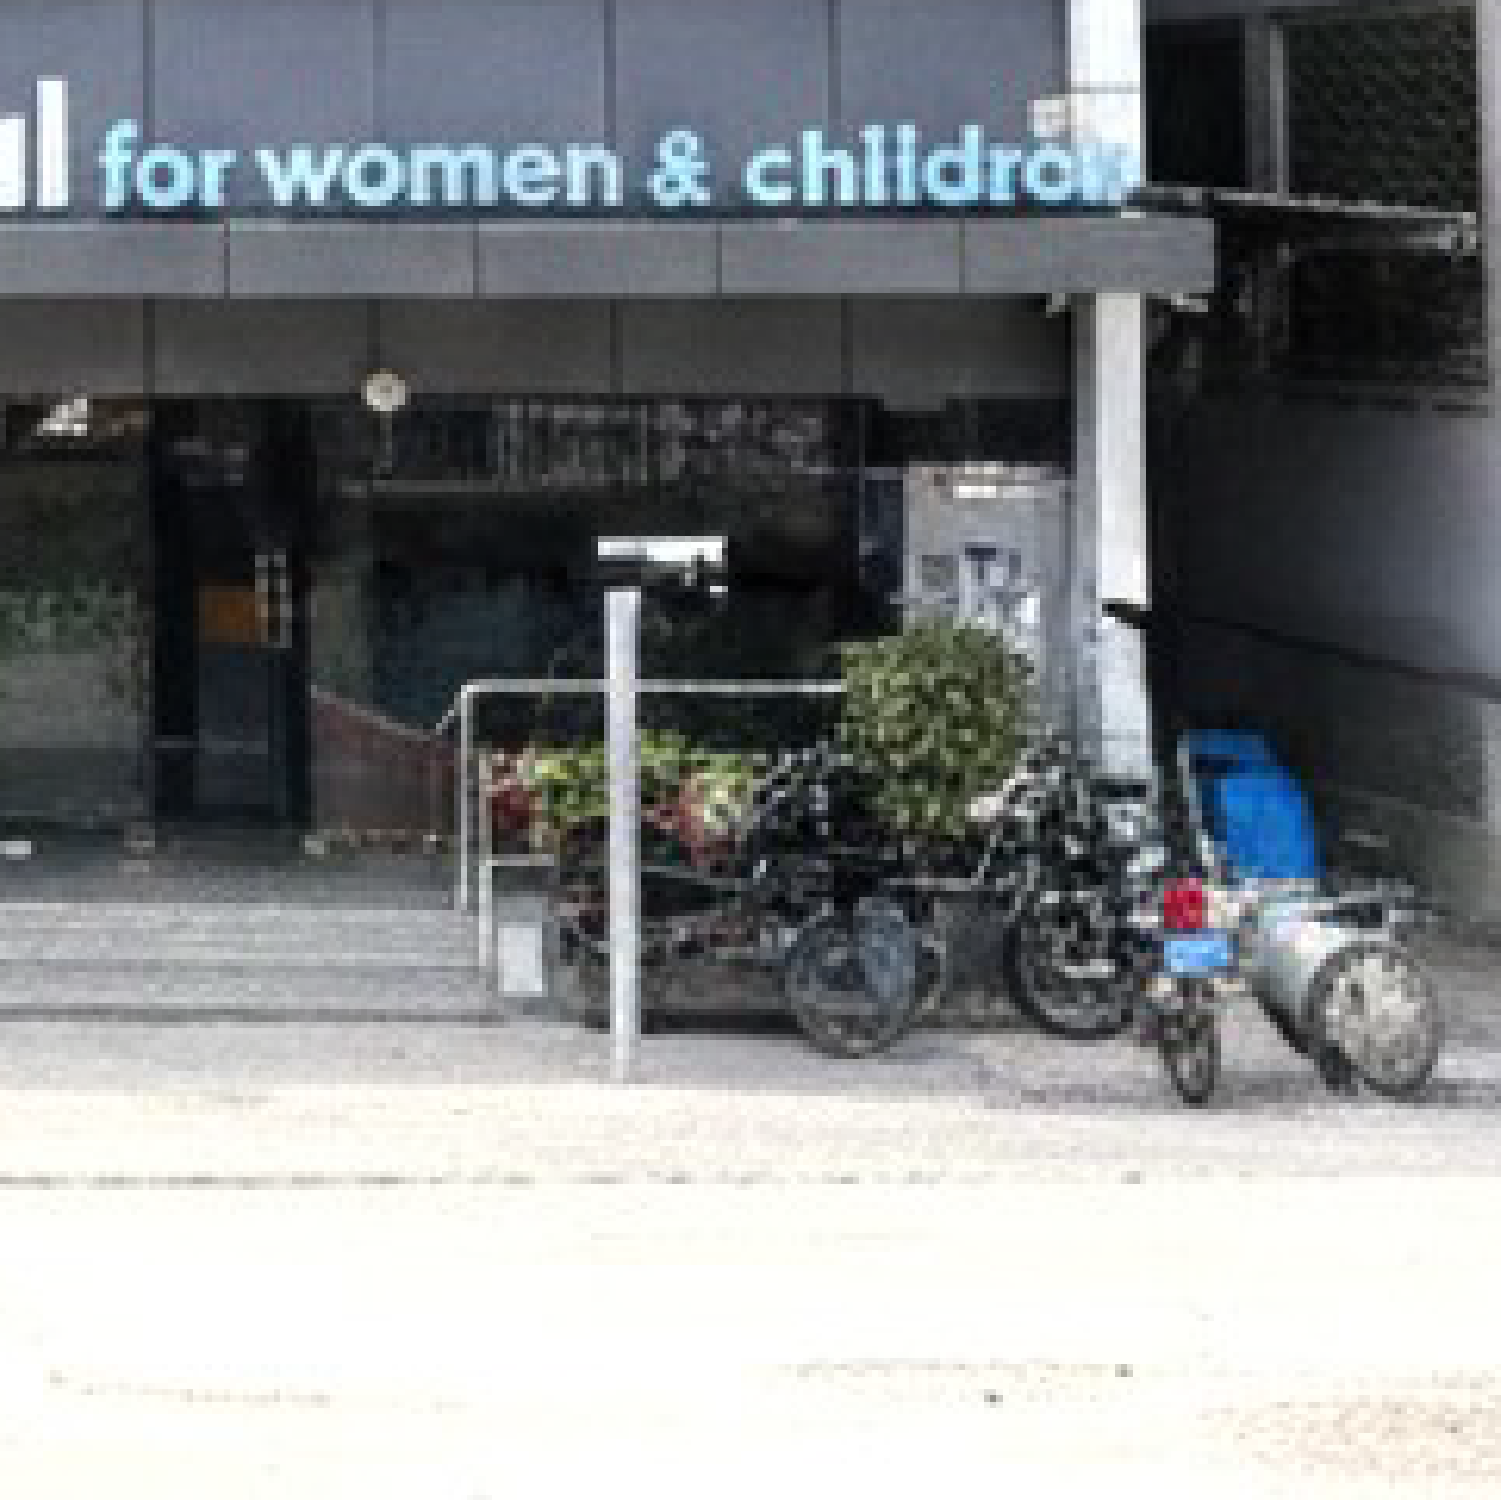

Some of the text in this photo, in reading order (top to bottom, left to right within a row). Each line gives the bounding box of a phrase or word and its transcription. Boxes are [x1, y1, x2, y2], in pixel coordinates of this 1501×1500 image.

[99, 118, 237, 207] for
[254, 143, 625, 207] women
[647, 127, 711, 207] &
